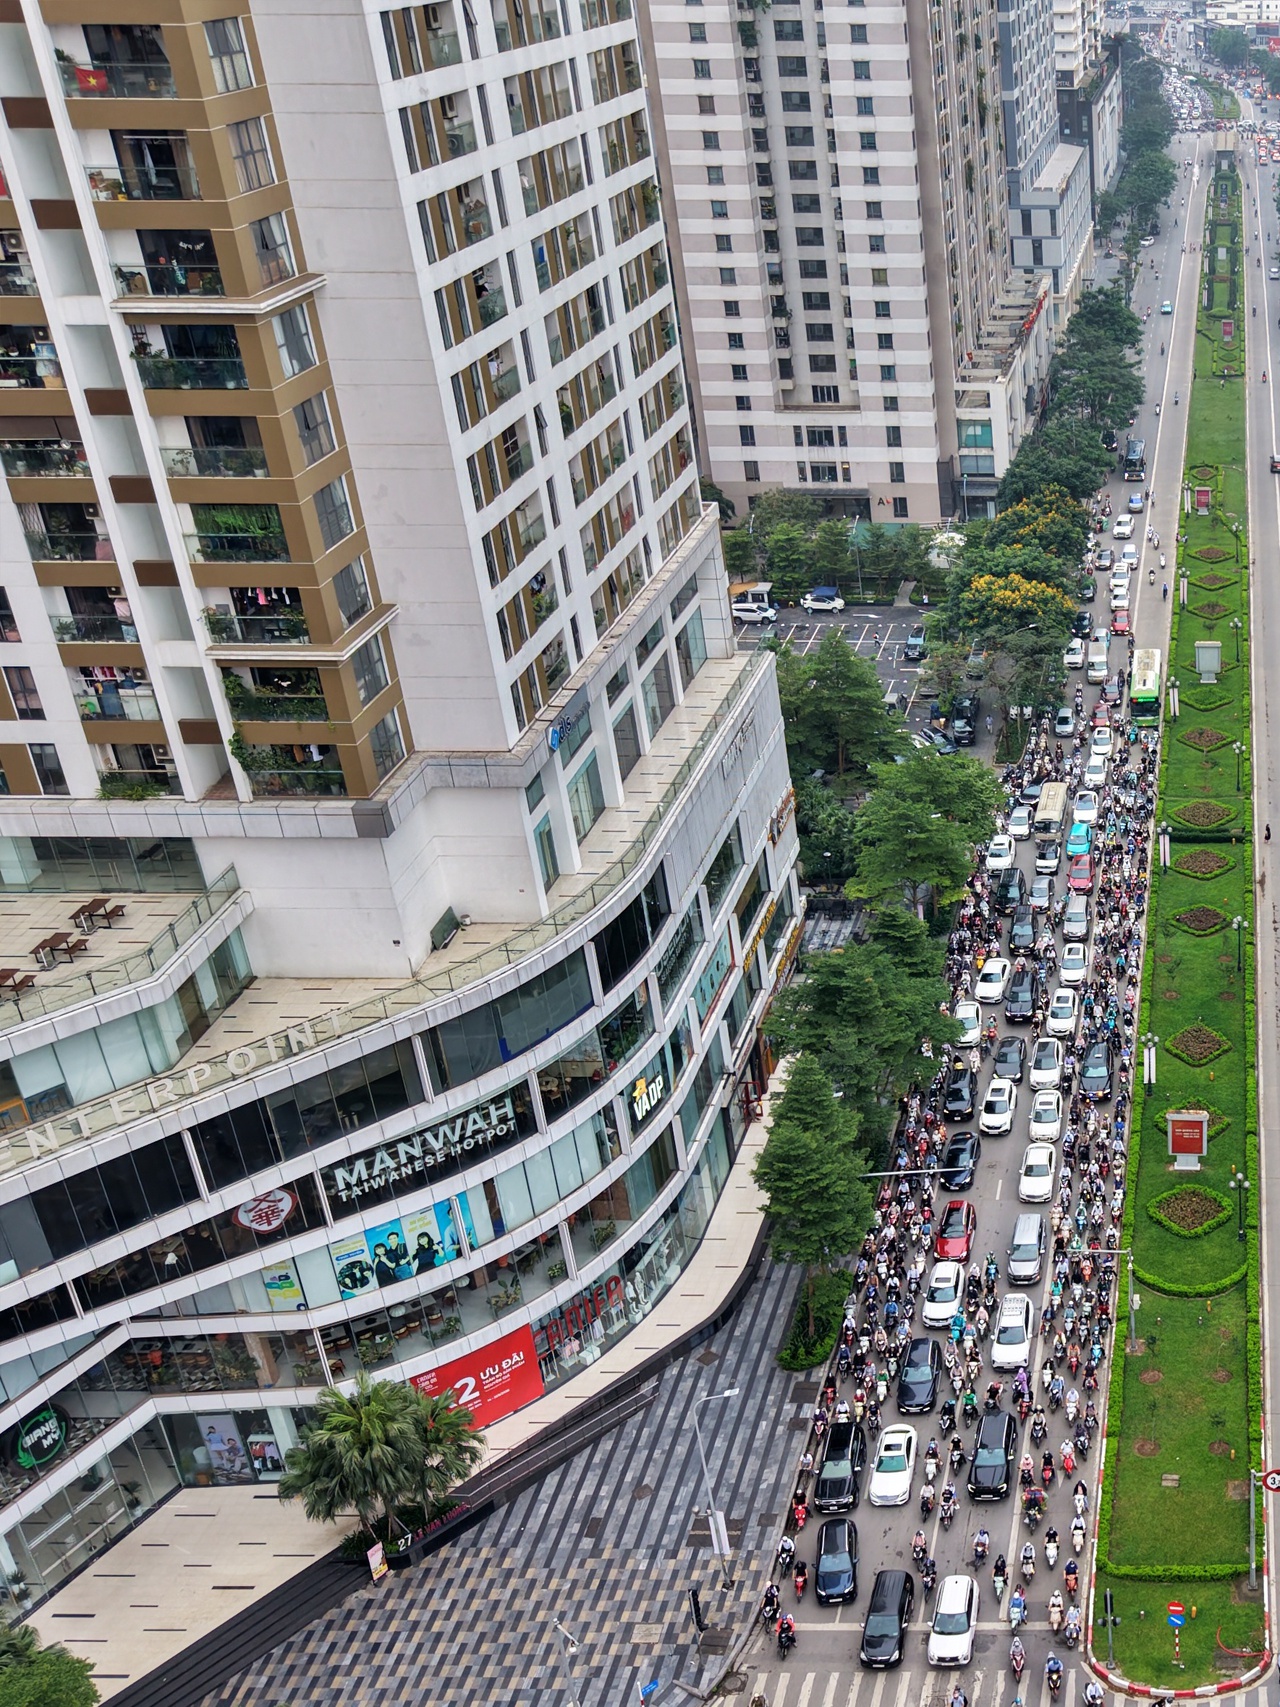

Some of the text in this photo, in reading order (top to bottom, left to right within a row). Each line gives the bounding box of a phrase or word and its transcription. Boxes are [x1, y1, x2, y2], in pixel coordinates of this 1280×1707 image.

[334, 1097, 515, 1191] MANWAH
[338, 1120, 516, 1202] TAIWANESE HOTPOT
[480, 1351, 524, 1379] ƯU ĐÃI
[22, 1417, 58, 1448] GIANG
[398, 1533, 412, 1552] 27
